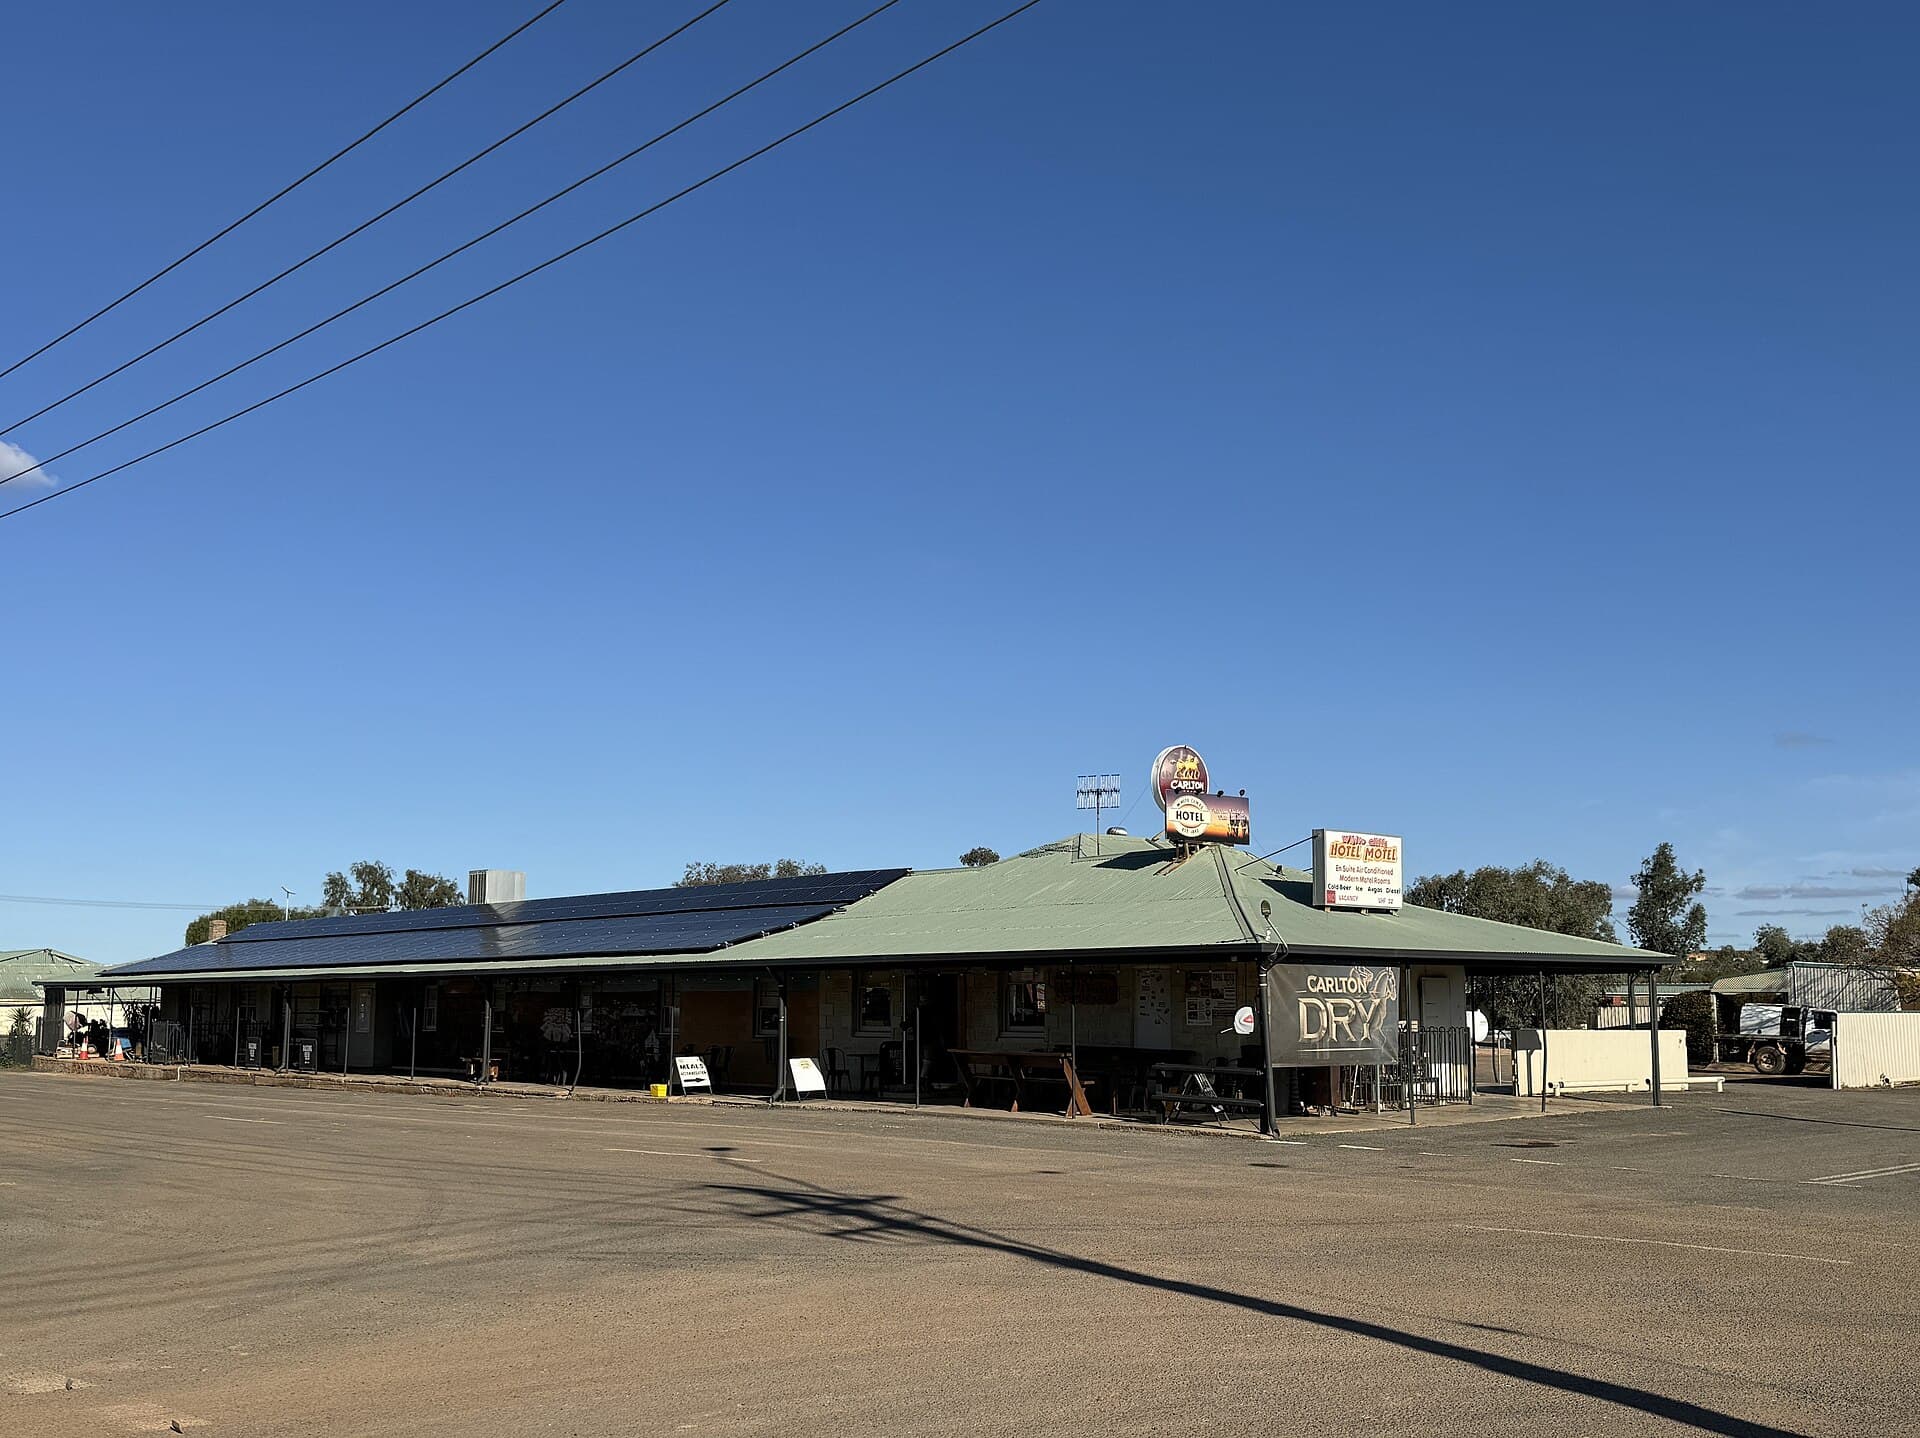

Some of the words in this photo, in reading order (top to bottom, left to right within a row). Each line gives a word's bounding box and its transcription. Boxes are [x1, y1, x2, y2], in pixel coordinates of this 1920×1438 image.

[1170, 780, 1204, 790] CARLTON
[1176, 810, 1205, 822] HOTEL
[1330, 842, 1360, 858] HOTEL
[1364, 848, 1396, 860] MOTEL
[1364, 866, 1394, 876] Conditioned
[1340, 874, 1358, 882] Modern
[1307, 975, 1368, 993] CARLTON
[1297, 997, 1381, 1043] DRY
